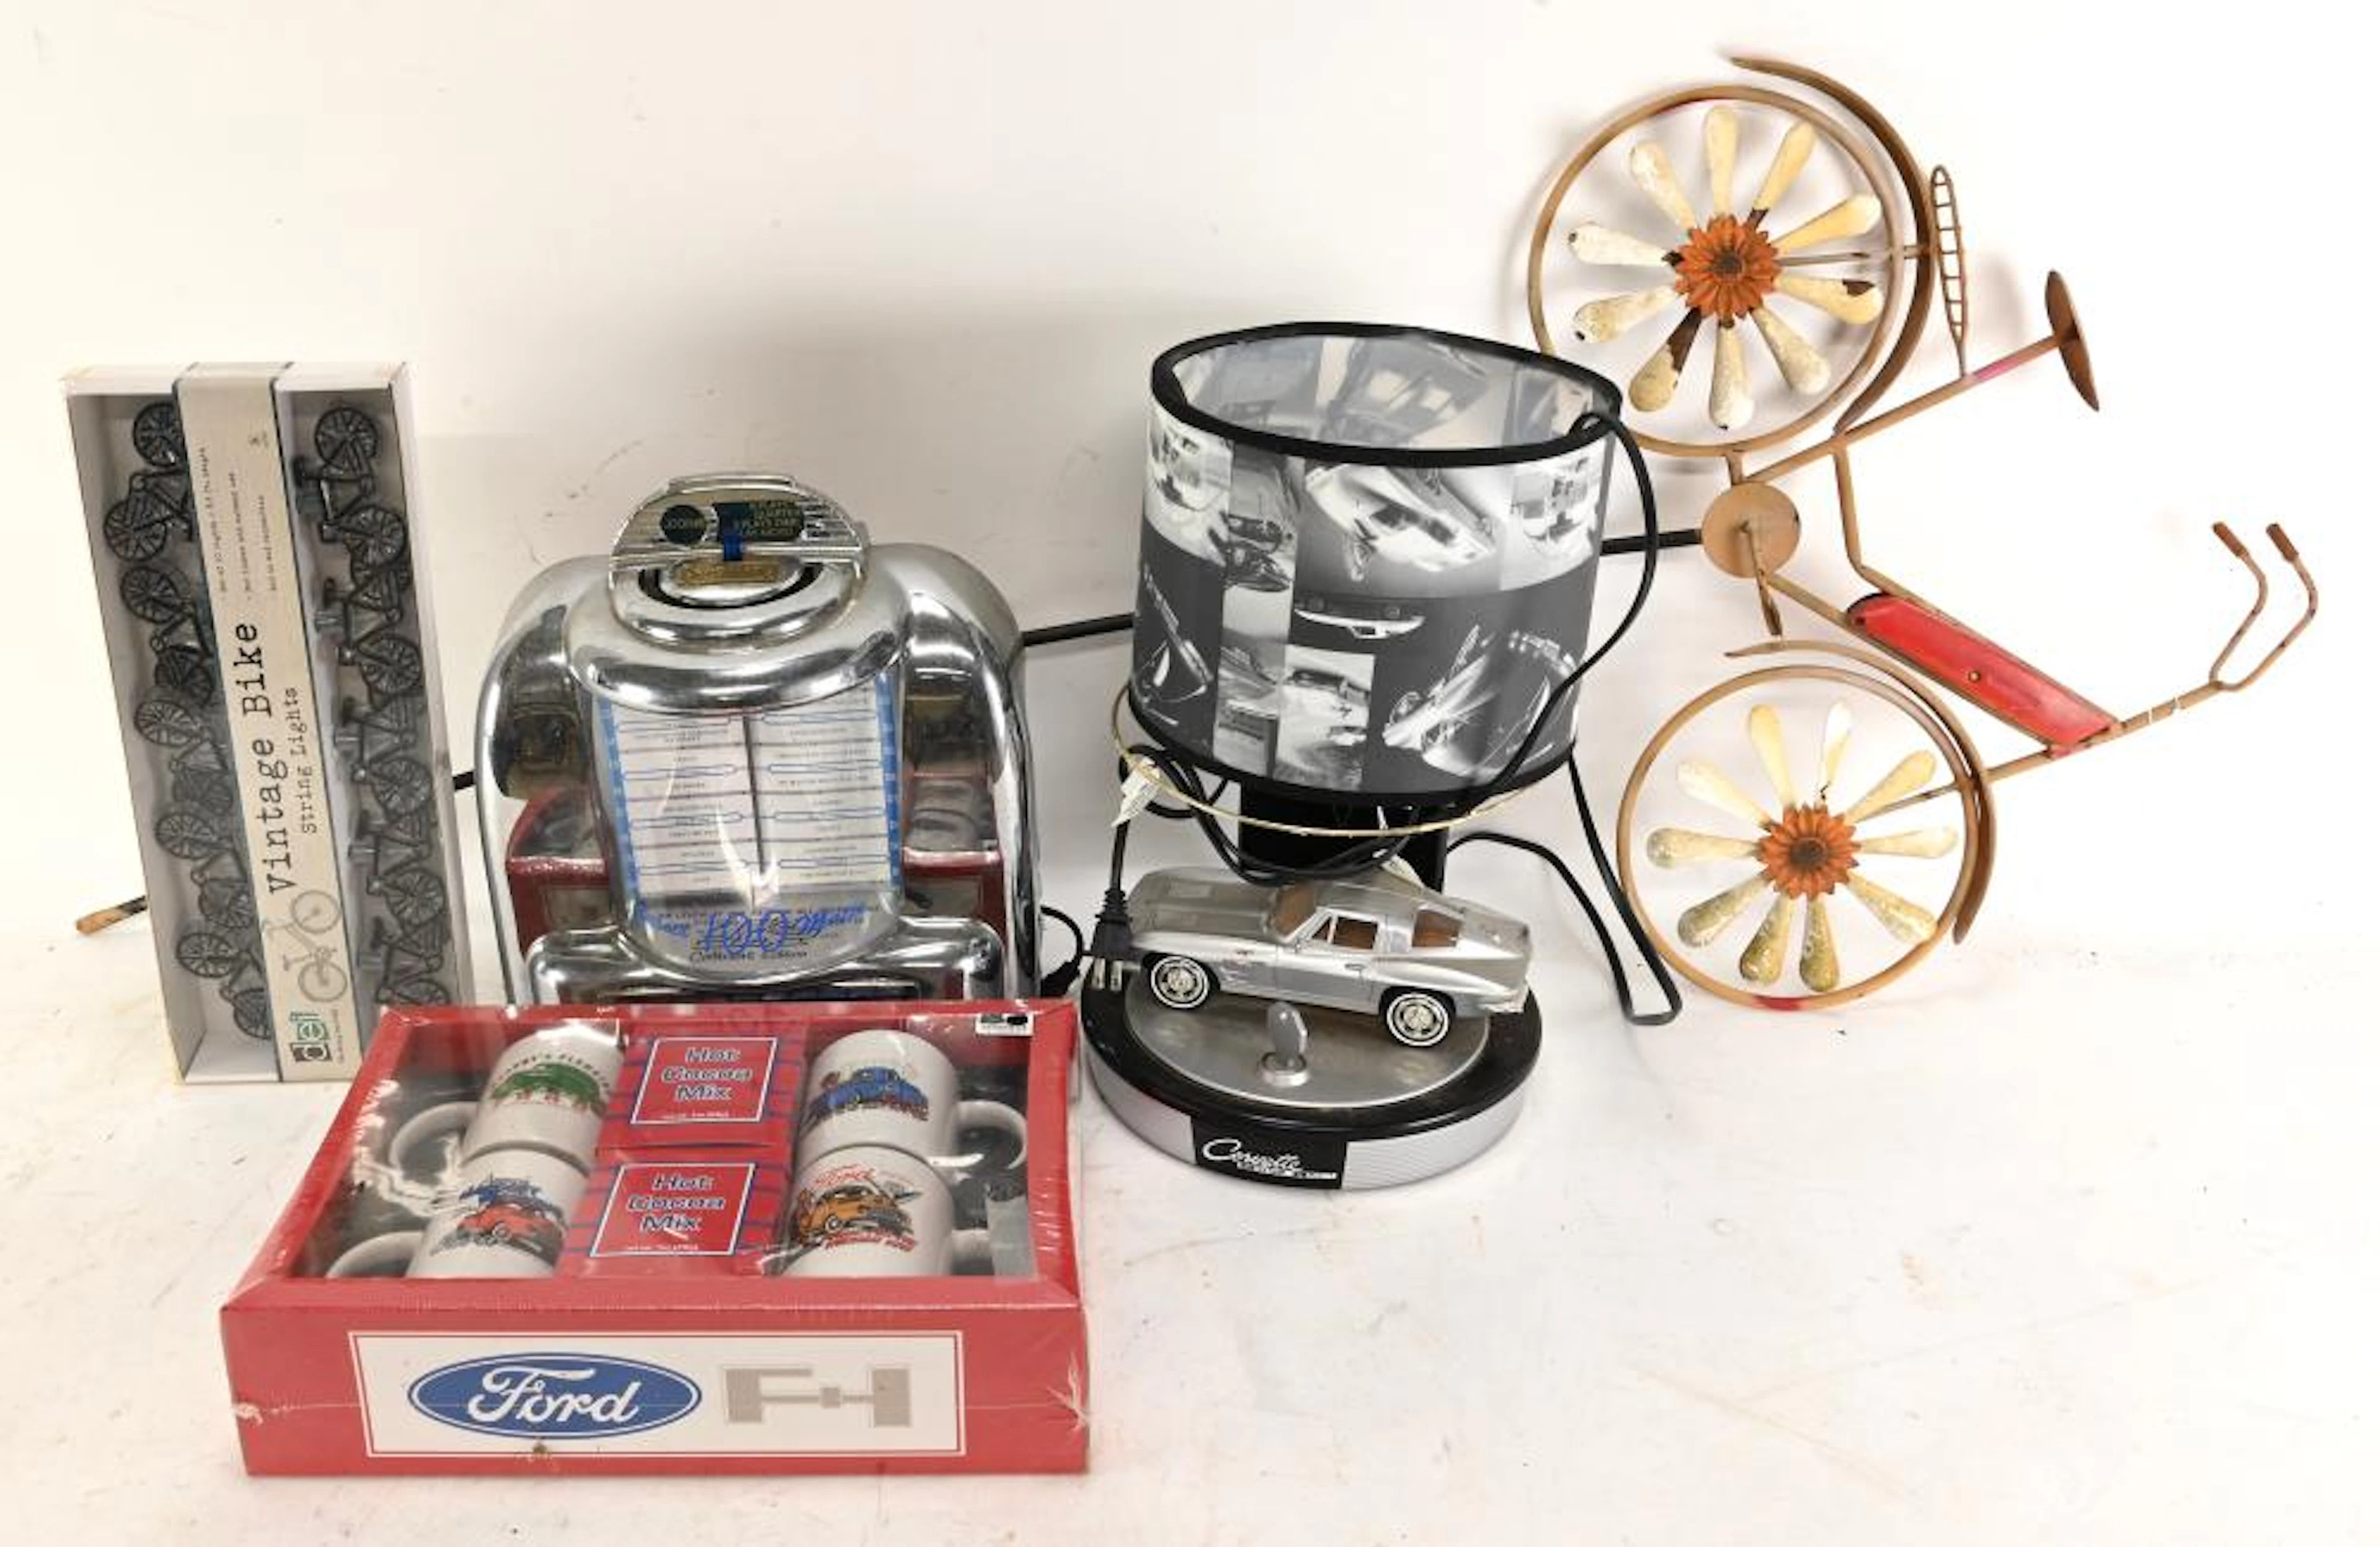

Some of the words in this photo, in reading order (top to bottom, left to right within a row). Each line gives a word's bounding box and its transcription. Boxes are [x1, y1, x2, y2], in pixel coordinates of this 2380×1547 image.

[234, 623, 271, 717] Bike
[284, 687, 307, 756] Lights
[294, 767, 317, 834] String
[252, 738, 296, 893] Vintage
[684, 1047, 741, 1062] Hot
[661, 1066, 753, 1083] Cocoa
[675, 1085, 734, 1101] Mix
[651, 1173, 715, 1191] Hot
[625, 1193, 726, 1212] Cocoa
[639, 1212, 702, 1233] Mix
[467, 1364, 644, 1424] Ford
